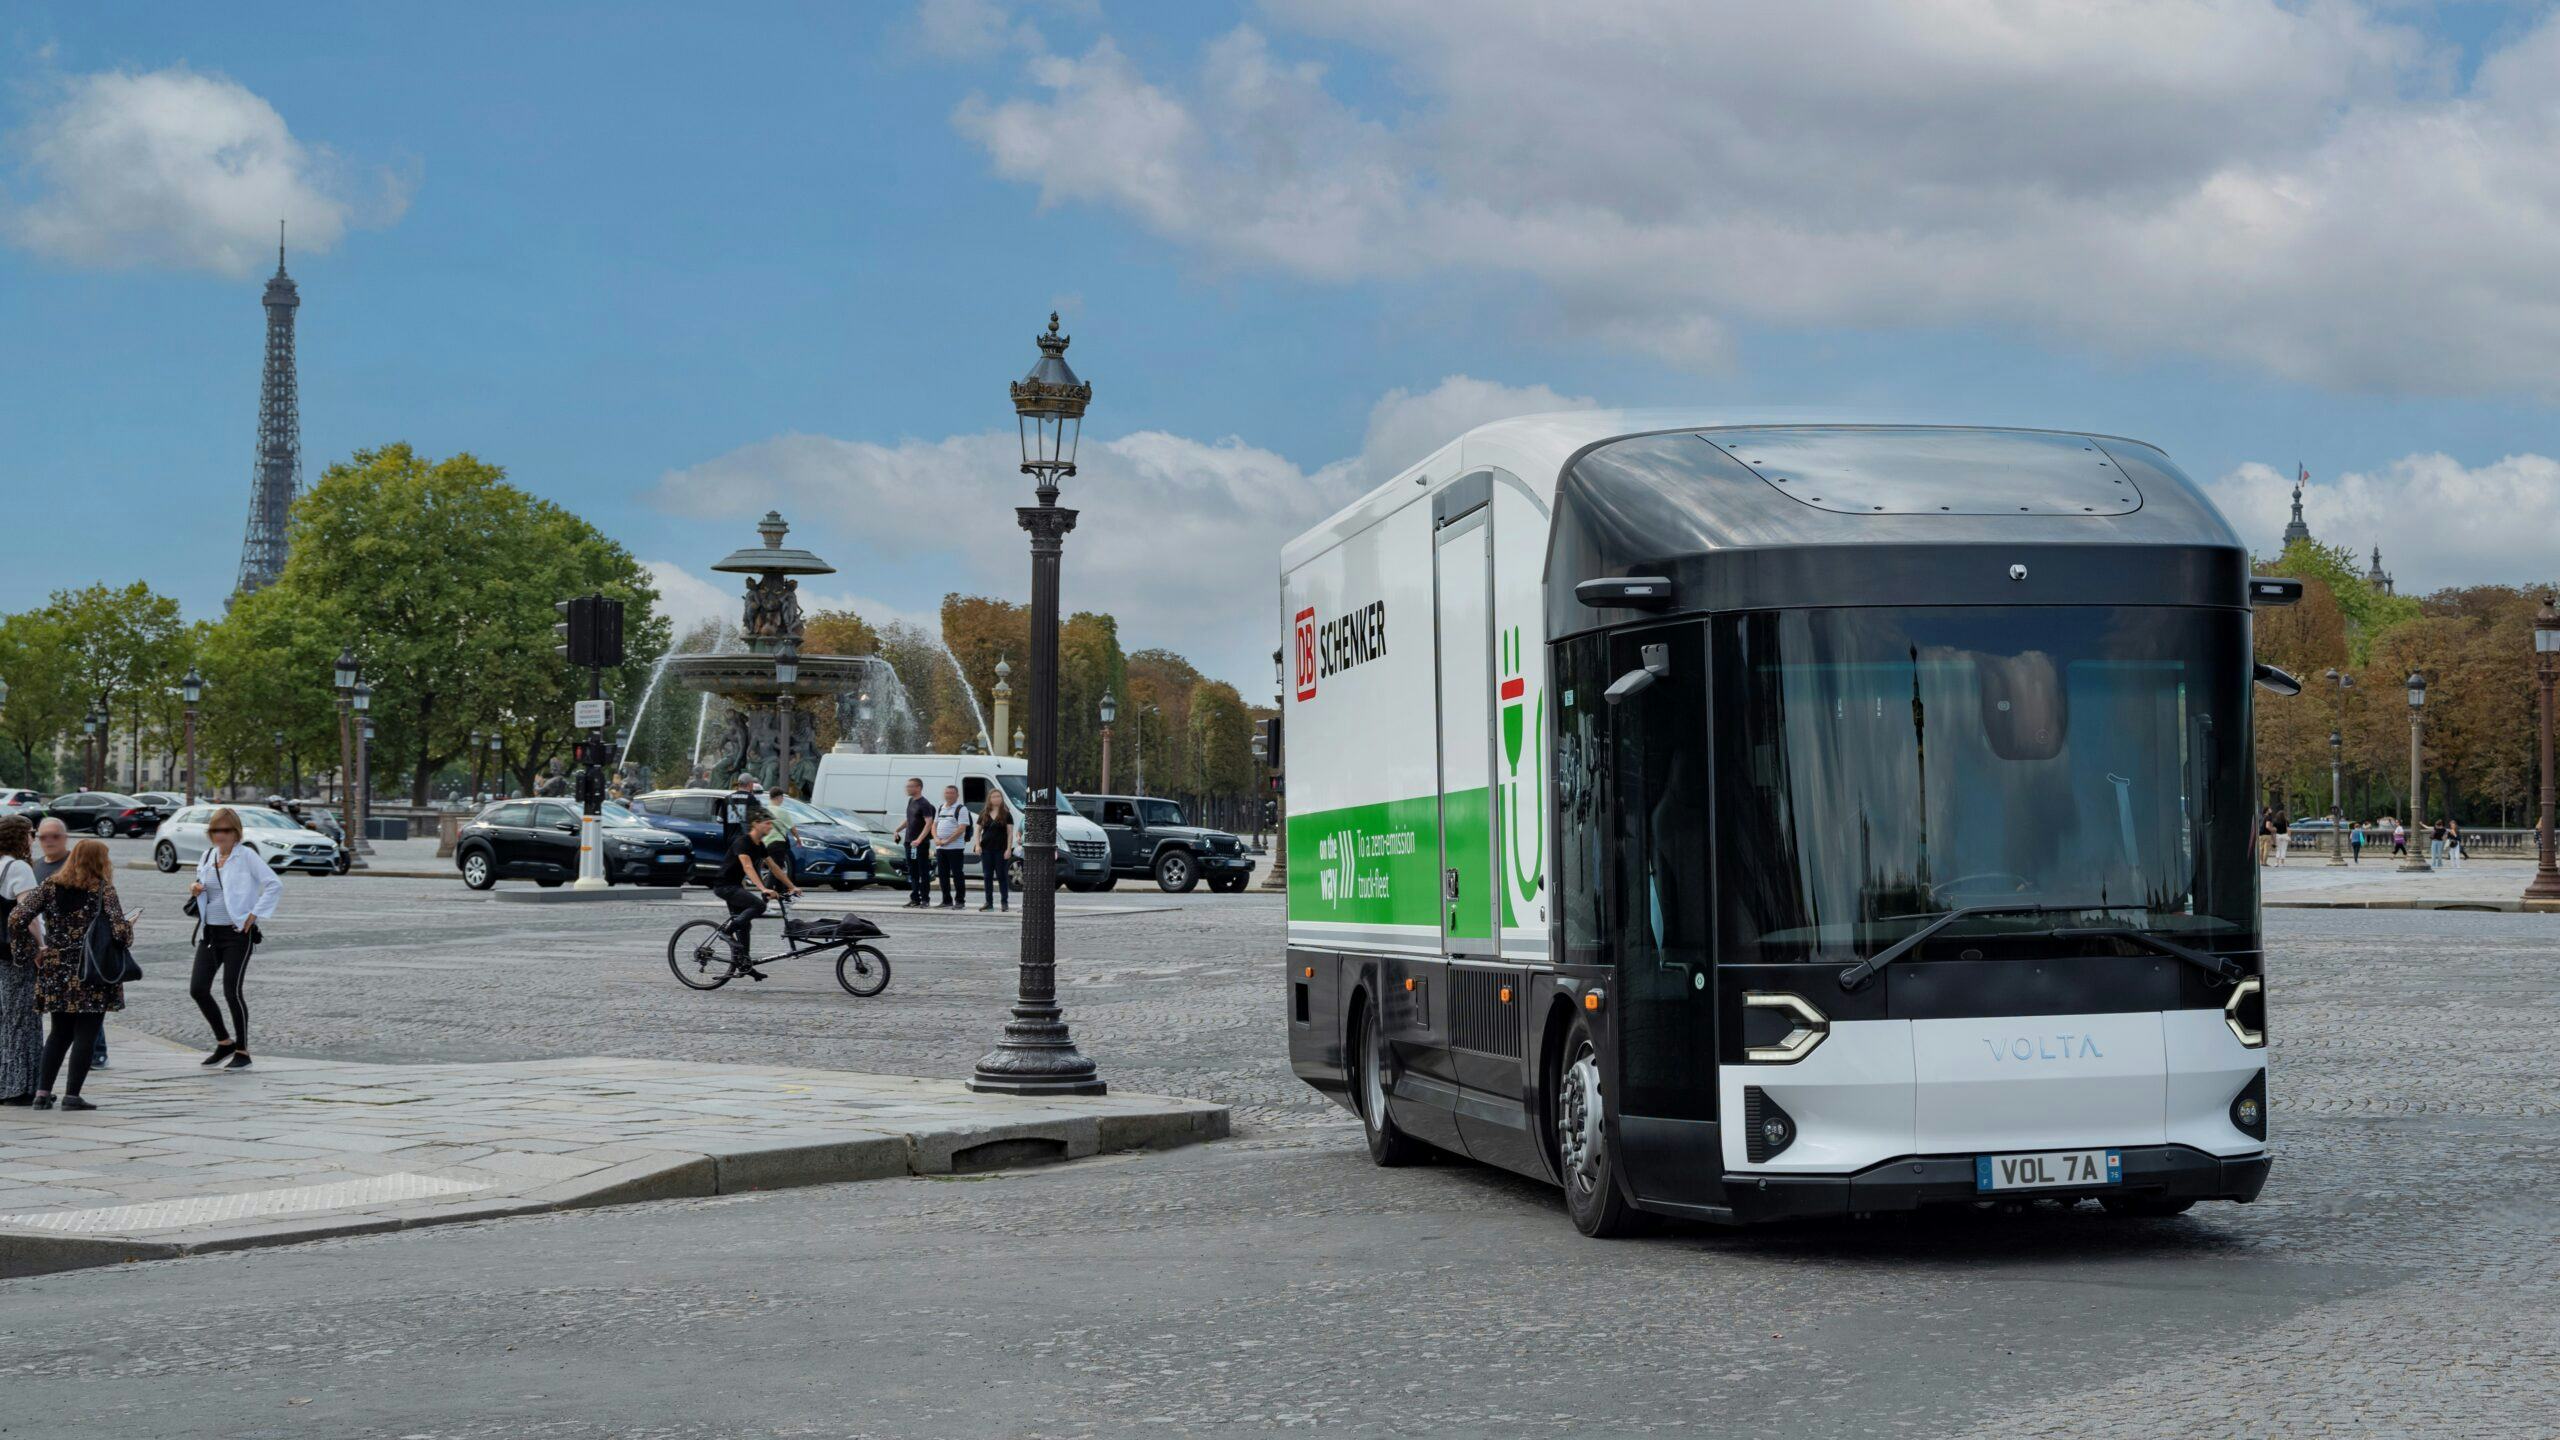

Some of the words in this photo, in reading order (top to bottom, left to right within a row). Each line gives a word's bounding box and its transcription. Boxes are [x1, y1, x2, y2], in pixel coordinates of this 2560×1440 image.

[1298, 624, 1314, 687] DB
[1320, 600, 1387, 679] SCHENKER
[1320, 839, 1328, 860] on
[1328, 833, 1338, 860] the
[1357, 829, 1365, 858] To
[1366, 836, 1371, 858] a
[1371, 824, 1415, 856] zero-emission
[1320, 868, 1338, 910] way
[1982, 1034, 2104, 1062] VOLTA
[1983, 1178, 1989, 1187] F
[2001, 1157, 2055, 1185] VOL
[2063, 1155, 2098, 1181] 7A
[2110, 1171, 2120, 1179] 75
